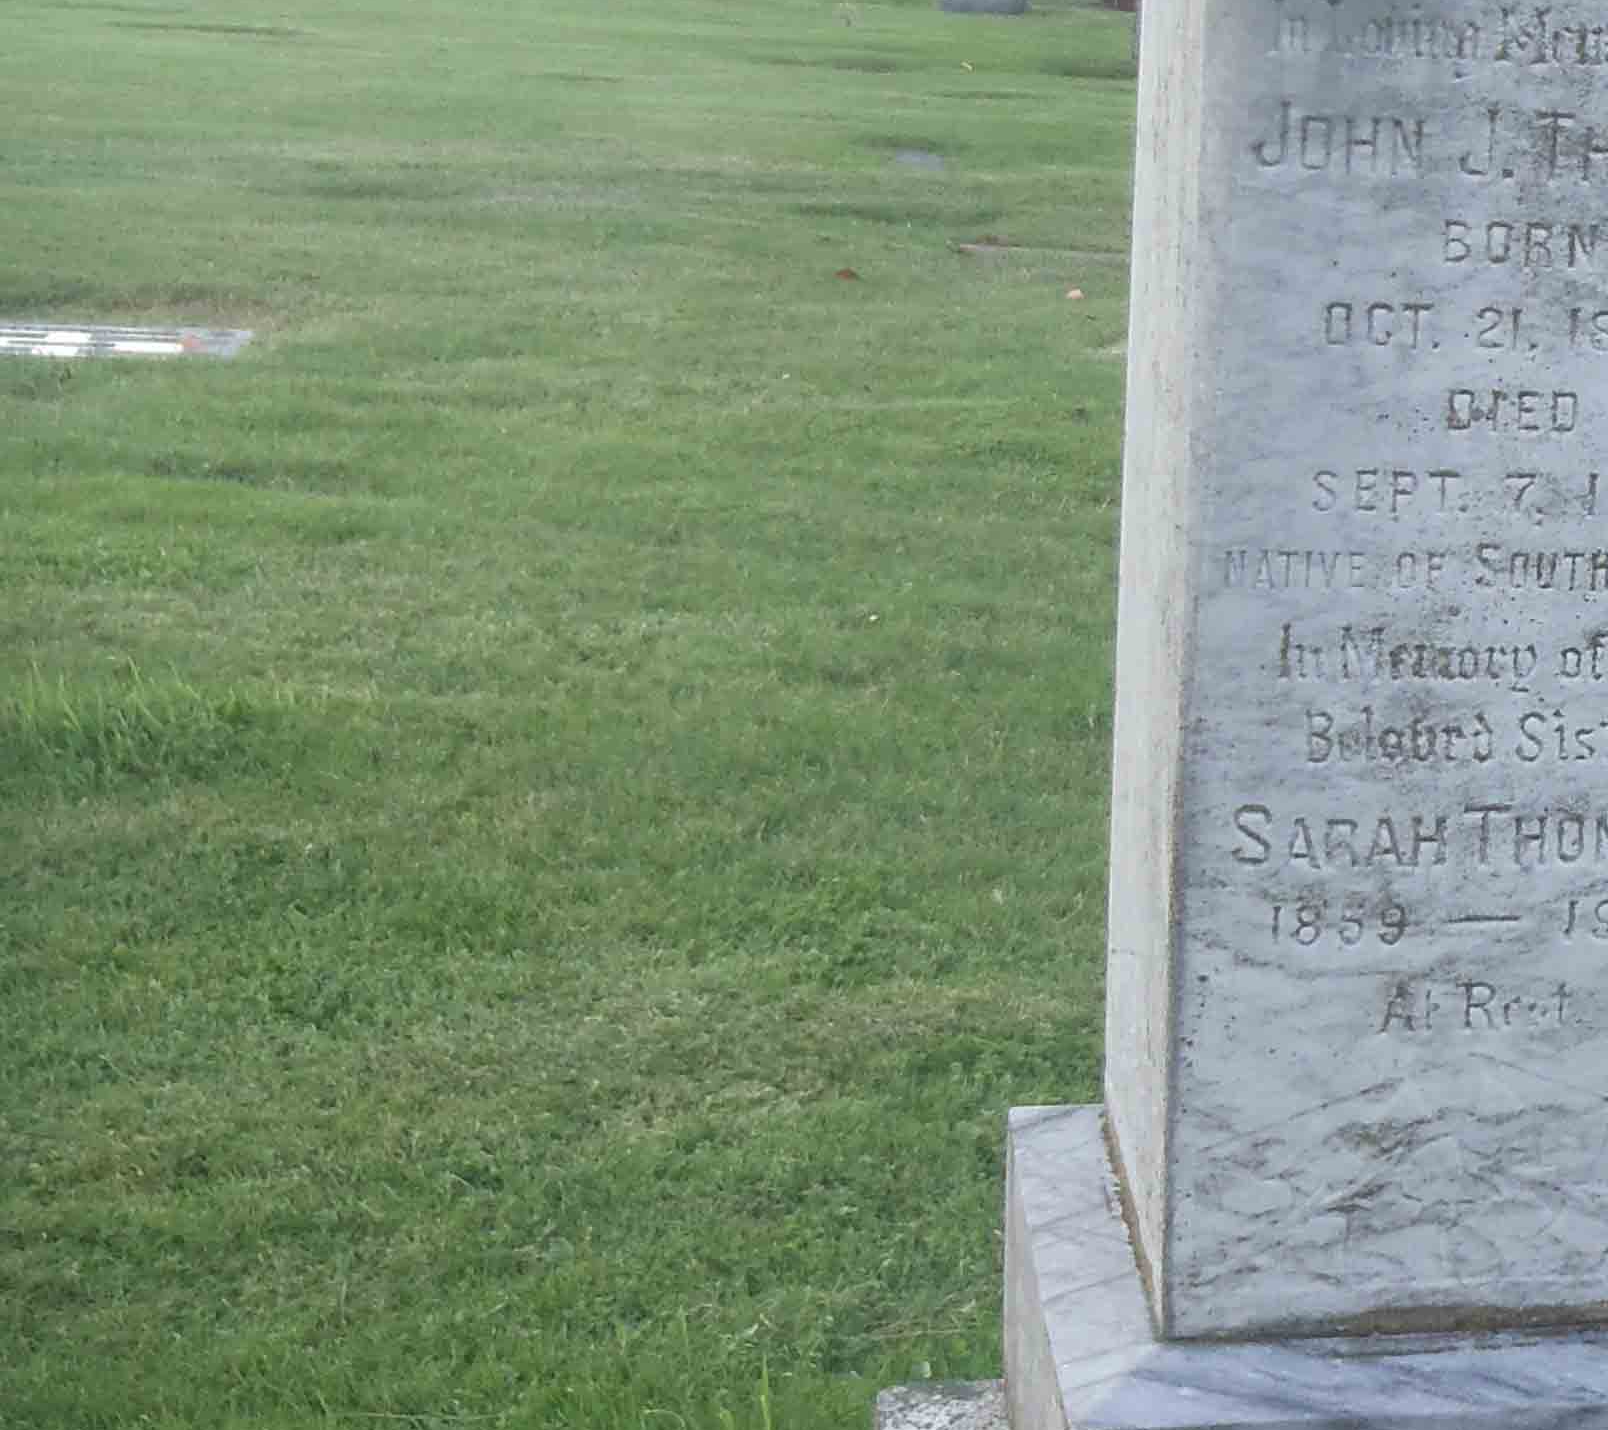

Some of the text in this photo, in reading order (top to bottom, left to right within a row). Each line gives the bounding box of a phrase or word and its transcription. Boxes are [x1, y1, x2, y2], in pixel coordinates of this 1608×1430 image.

[1250, 100, 1425, 173] JOHN
[1457, 108, 1513, 179] J.
[1442, 219, 1598, 268] BORN
[1324, 302, 1440, 351] OCT.
[1447, 387, 1578, 433] DIED
[1222, 548, 1368, 591] NATIVE
[1396, 550, 1449, 592] OF
[1277, 623, 1323, 679] In
[1340, 625, 1538, 693] Memory
[1231, 803, 1450, 869] SARAH
[1268, 903, 1408, 947] 1859
